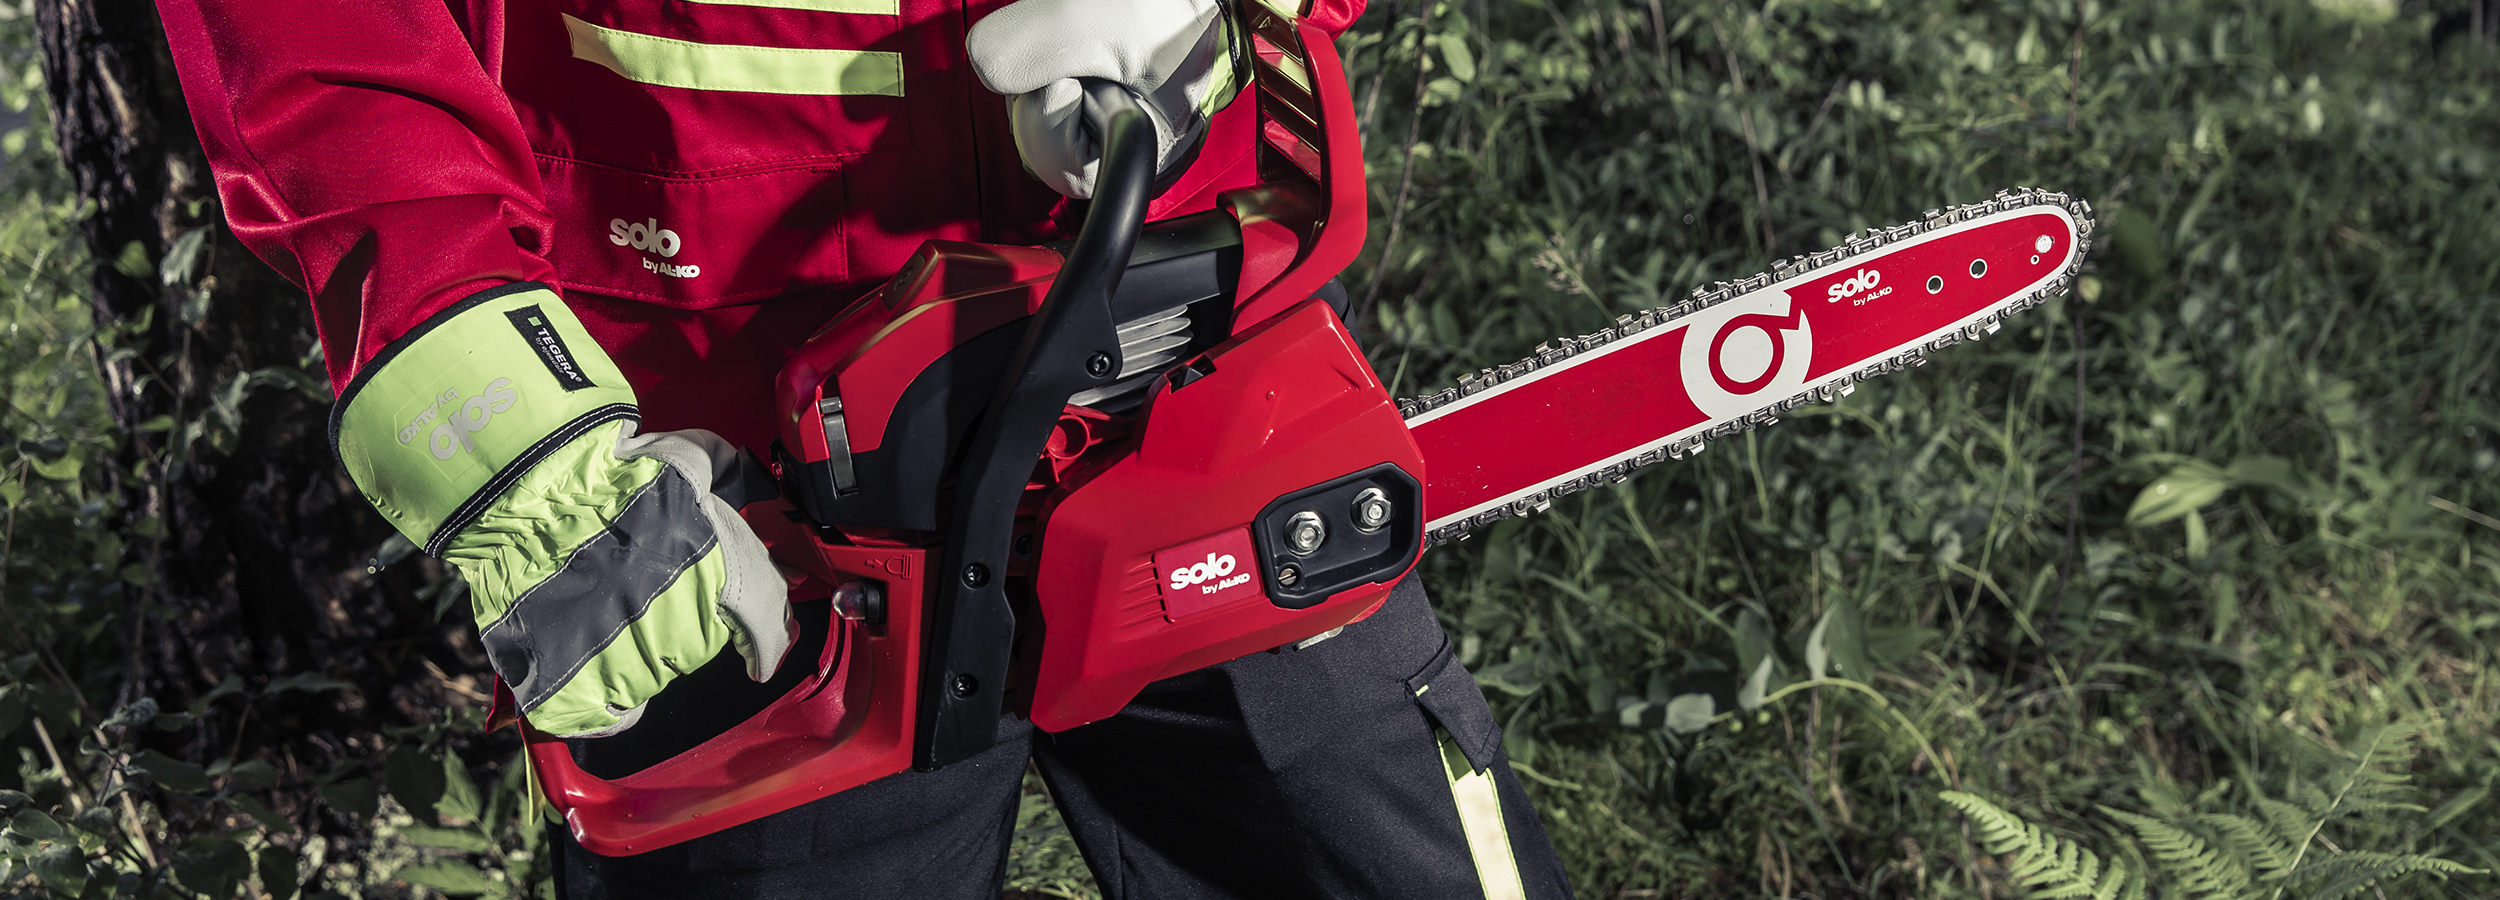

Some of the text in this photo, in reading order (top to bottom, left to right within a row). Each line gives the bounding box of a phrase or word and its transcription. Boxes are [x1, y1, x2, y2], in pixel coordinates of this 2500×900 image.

[609, 217, 681, 258] solo
[642, 256, 659, 274] by
[1828, 268, 1881, 303] solo
[1853, 297, 1866, 306] by
[398, 386, 460, 444] by AL-KO
[429, 377, 517, 460] solo
[1170, 552, 1236, 590] solo
[1202, 583, 1218, 595] by
